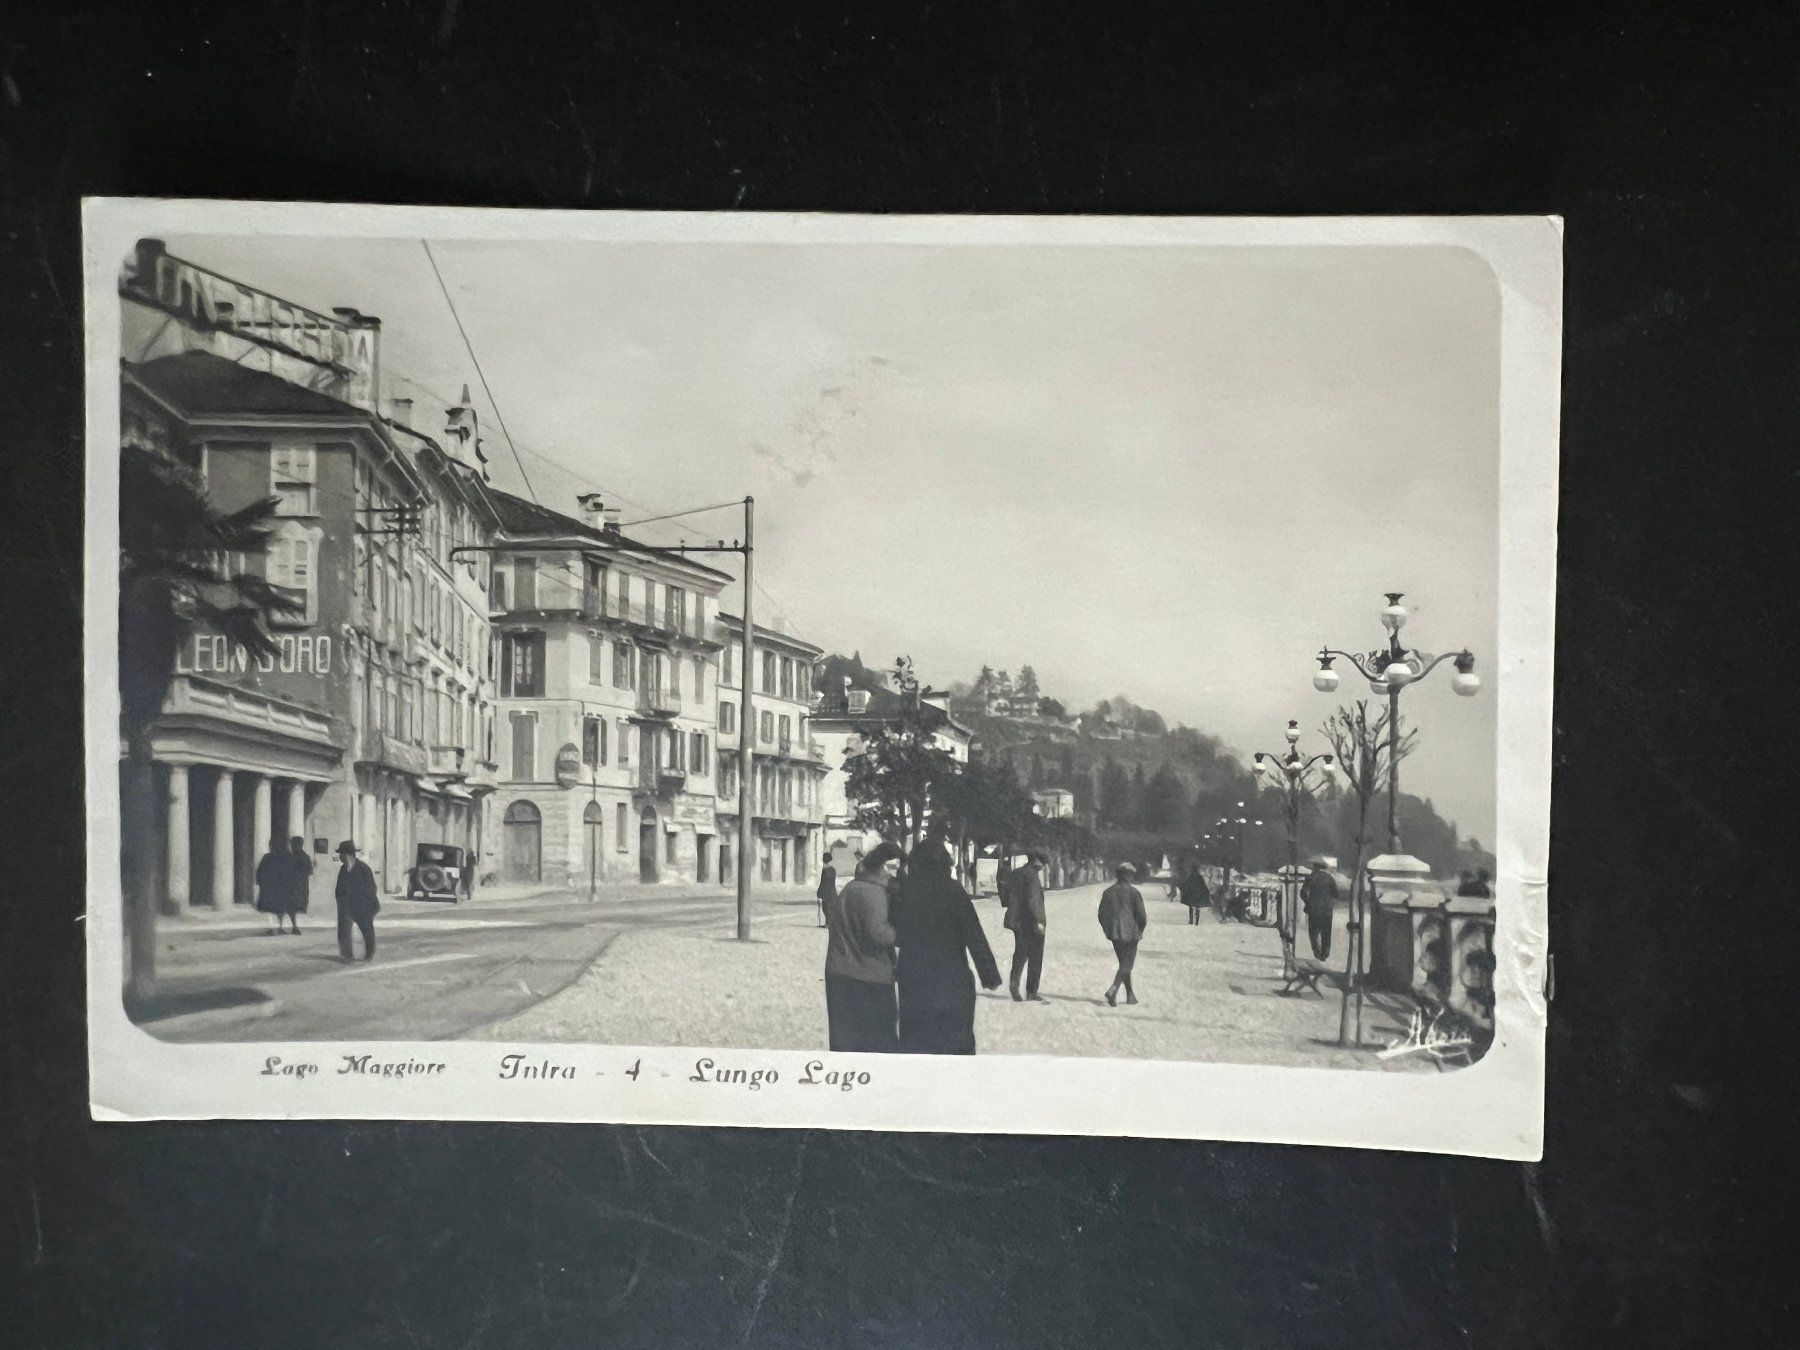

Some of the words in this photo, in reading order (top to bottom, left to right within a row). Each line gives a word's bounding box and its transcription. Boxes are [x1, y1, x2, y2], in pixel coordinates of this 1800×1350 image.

[261, 1056, 319, 1079] Lago
[337, 1055, 446, 1079] Maggiore
[499, 1054, 576, 1079] Intra
[625, 1058, 641, 1081] 4
[688, 1058, 779, 1091] Lungo
[798, 1060, 871, 1092] Lago
